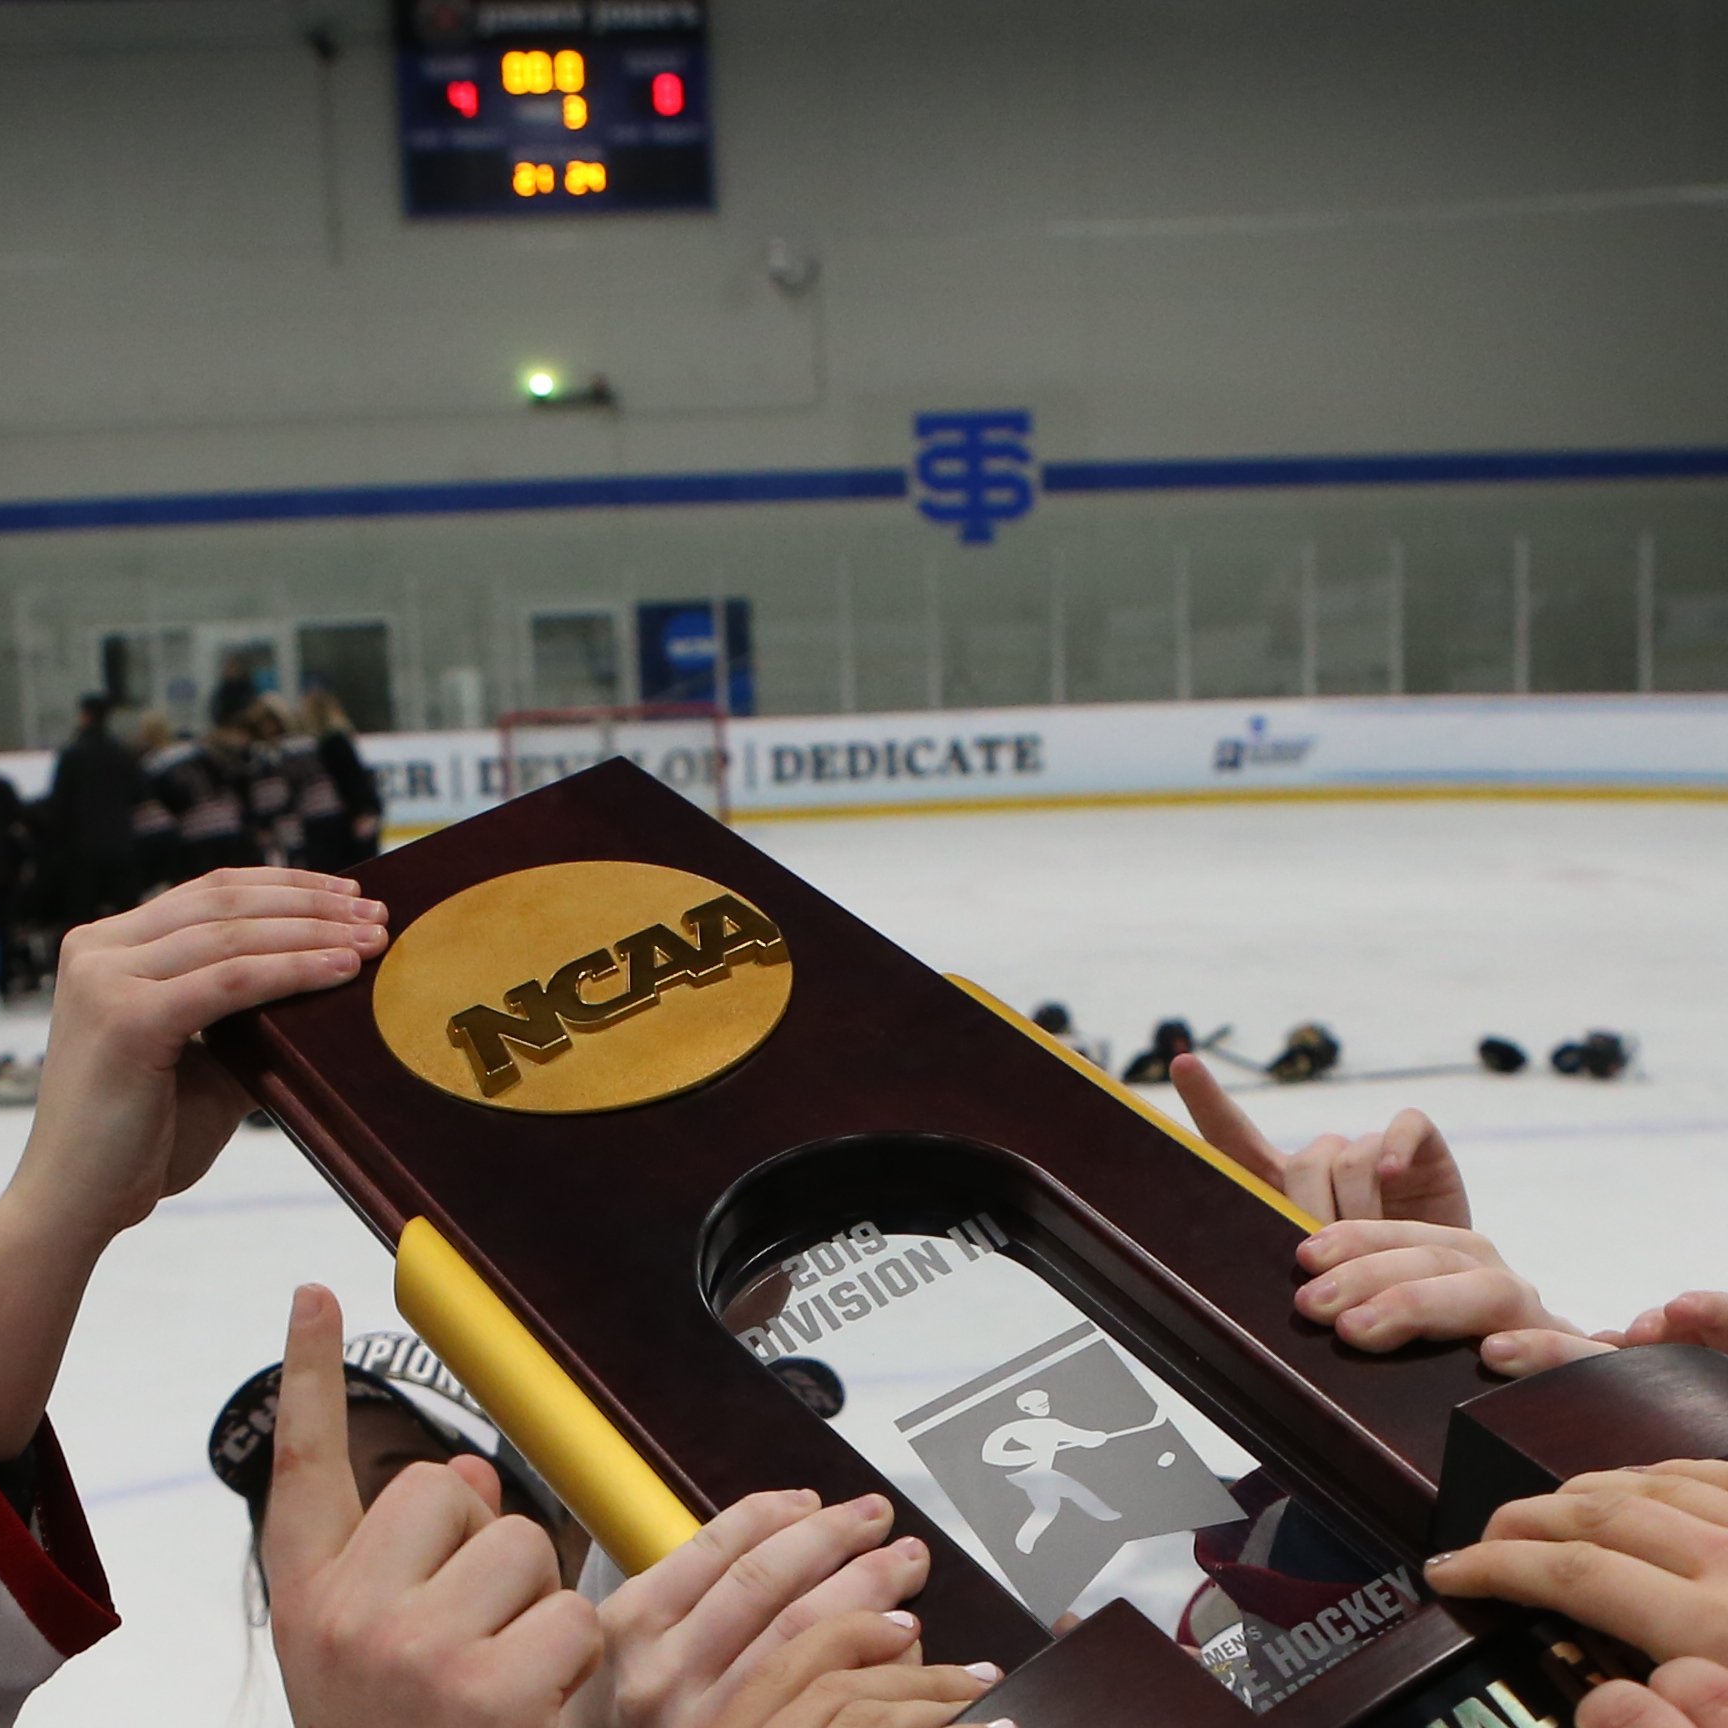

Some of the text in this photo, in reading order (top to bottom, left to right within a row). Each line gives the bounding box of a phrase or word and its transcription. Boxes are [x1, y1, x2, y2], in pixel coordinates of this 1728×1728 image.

[769, 732, 1044, 786] DEDICATE
[445, 893, 790, 1098] NCAA
[736, 1210, 1011, 1367] DIVISION III
[780, 1219, 888, 1293] 2019
[1204, 1624, 1263, 1666] MEN'S
[1262, 1564, 1421, 1679] HOCKEY
